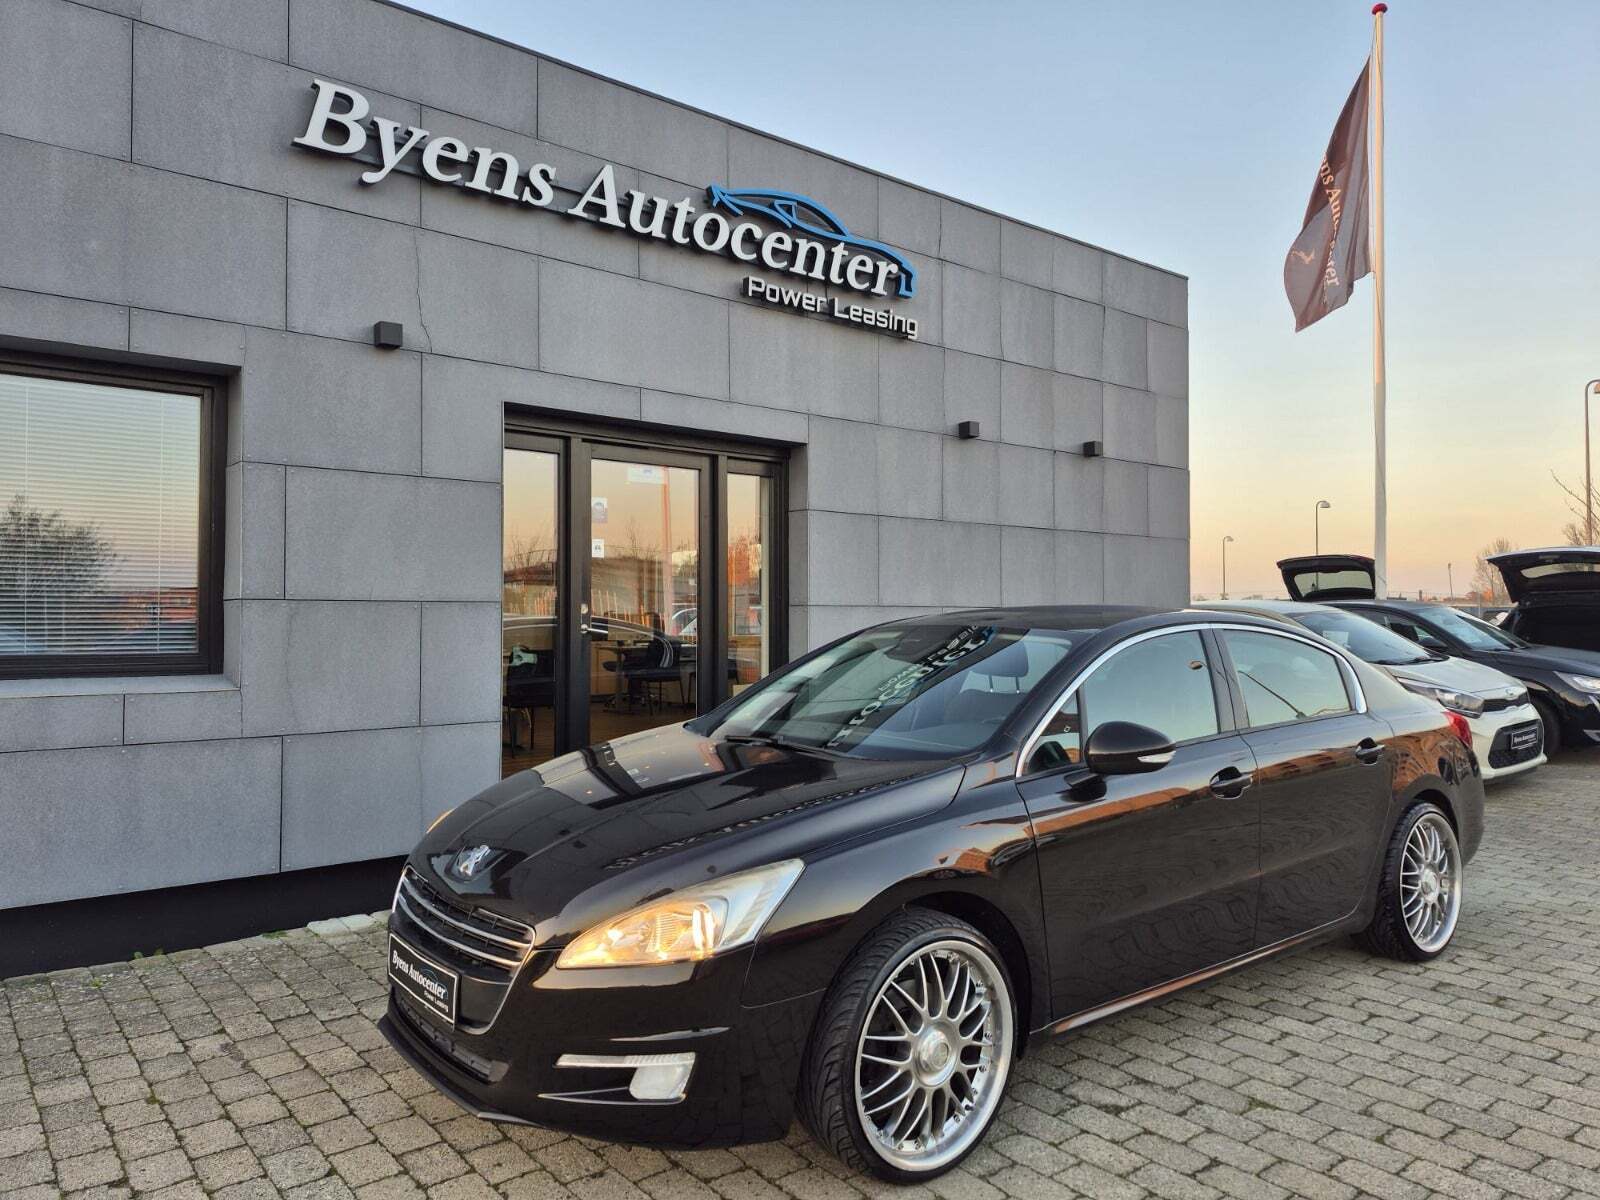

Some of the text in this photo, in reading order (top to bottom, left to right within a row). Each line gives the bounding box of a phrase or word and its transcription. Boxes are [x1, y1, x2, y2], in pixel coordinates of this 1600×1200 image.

[292, 79, 899, 296] Byens Autocenter
[747, 276, 919, 340] Power Leasing
[392, 949, 447, 999] Byens Autocenter
